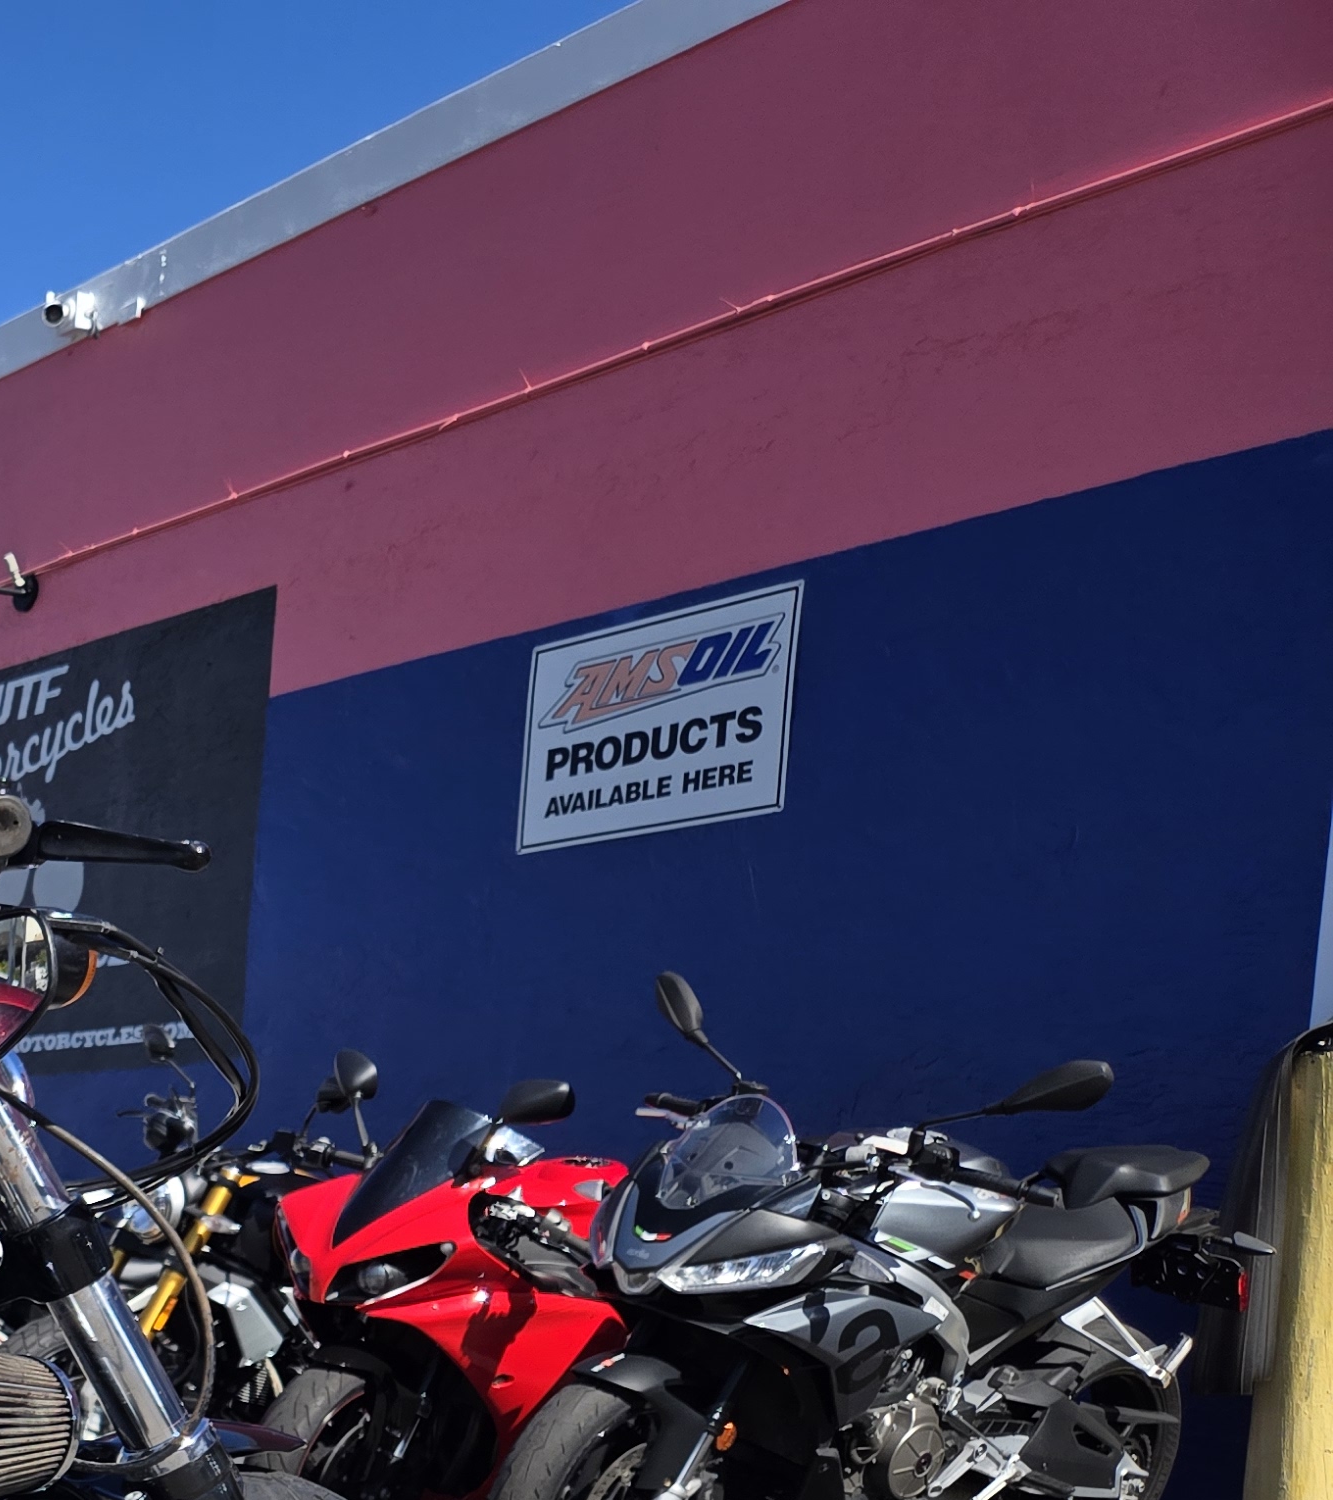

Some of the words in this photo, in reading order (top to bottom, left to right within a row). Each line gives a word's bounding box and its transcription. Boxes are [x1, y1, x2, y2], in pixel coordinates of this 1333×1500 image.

[551, 620, 776, 724] AMSOIL
[544, 705, 763, 782] PRODUCTS
[544, 775, 672, 819] AVAILABLE
[682, 760, 753, 795] HERE
